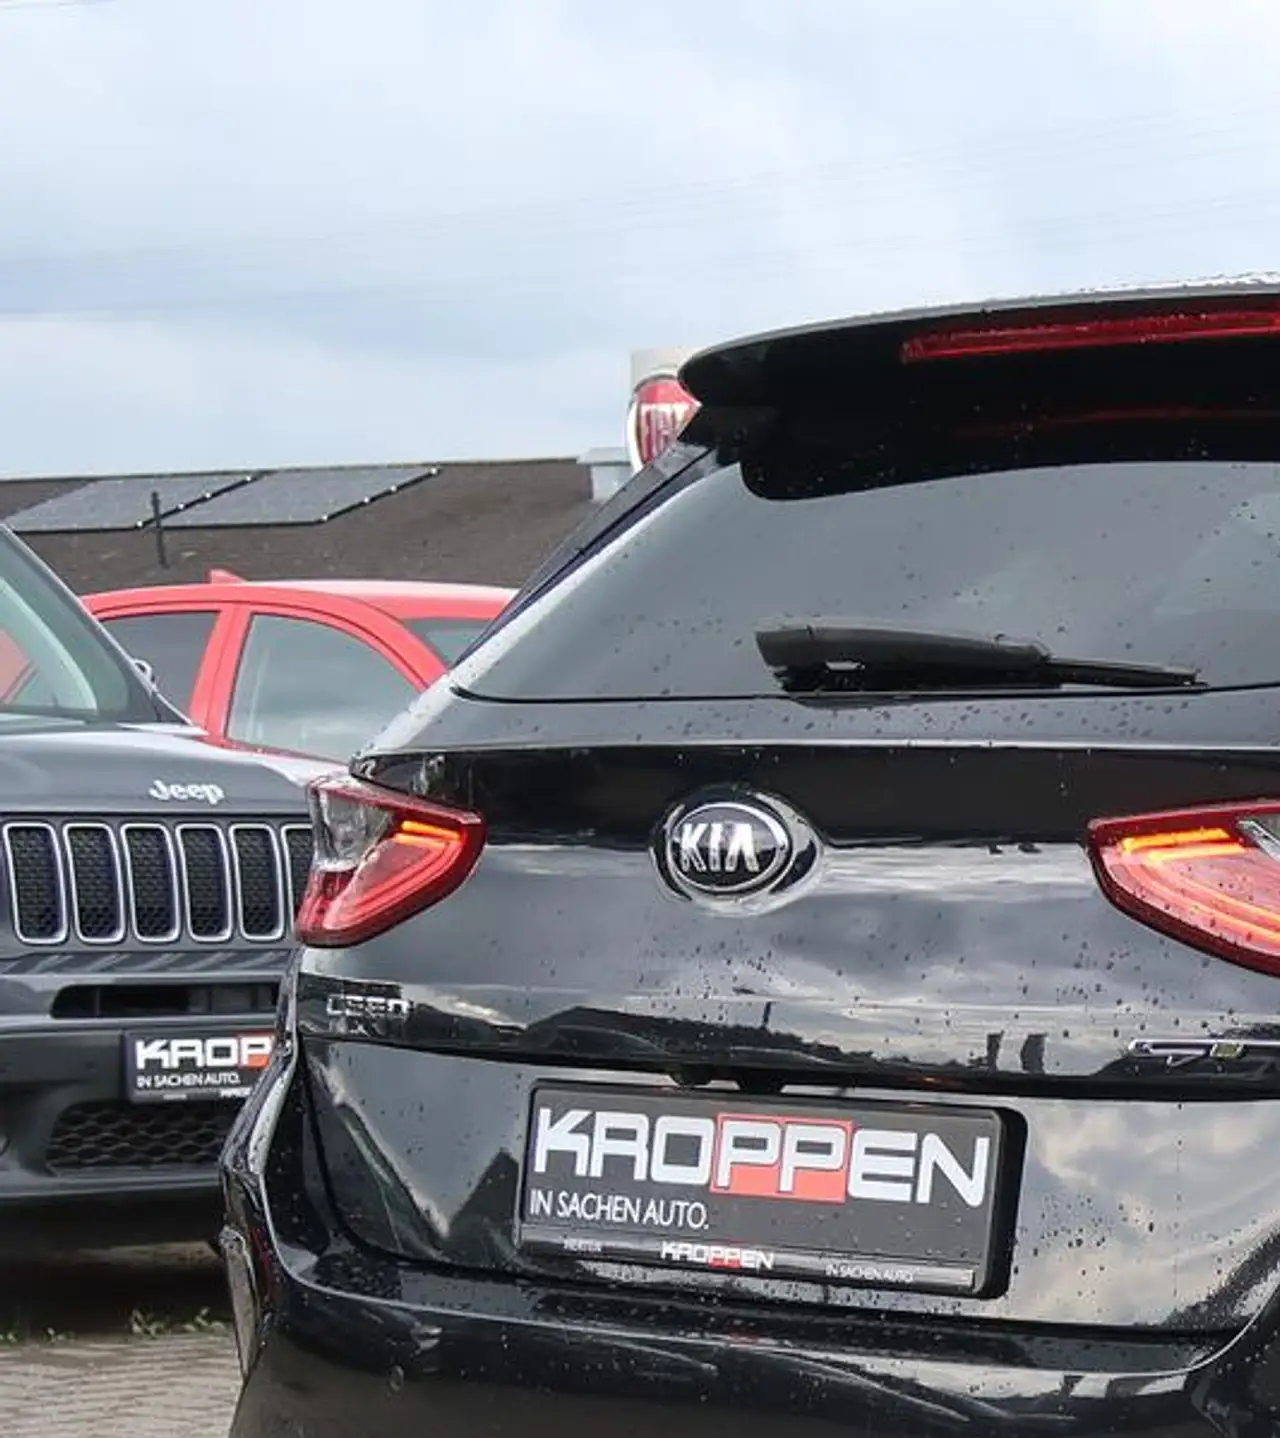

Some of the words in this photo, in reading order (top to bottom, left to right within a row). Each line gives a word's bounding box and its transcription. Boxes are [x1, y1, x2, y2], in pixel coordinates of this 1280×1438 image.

[148, 779, 225, 805] Jeep
[679, 822, 761, 873] KIA
[135, 1036, 273, 1070] KROP
[136, 1075, 152, 1088] IN
[153, 1073, 203, 1088] SACHEN
[534, 1107, 990, 1208] KROPPEN
[529, 1190, 549, 1216] IN
[556, 1192, 639, 1224] SACHEN
[638, 1199, 710, 1230] AUTO.
[659, 1240, 775, 1270] KROPPEN
